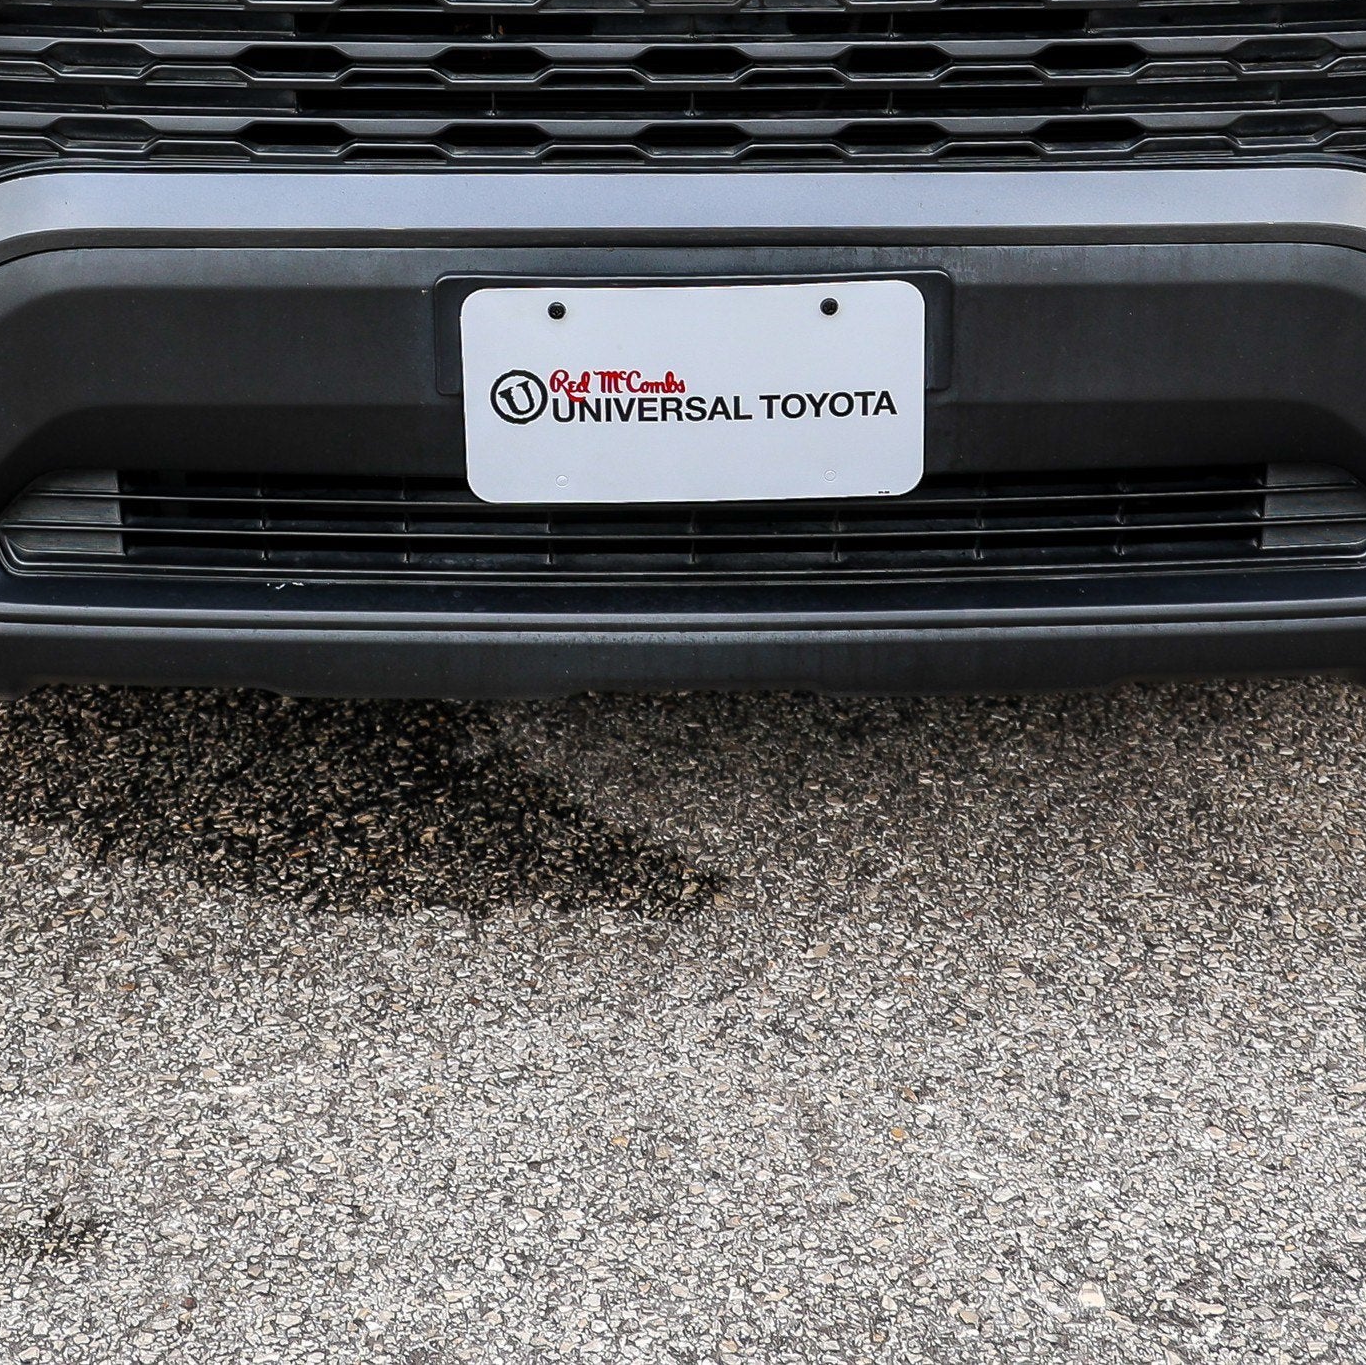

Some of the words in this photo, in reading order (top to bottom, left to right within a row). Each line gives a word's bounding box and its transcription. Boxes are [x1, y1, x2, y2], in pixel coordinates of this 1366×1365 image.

[549, 369, 590, 402] Red
[593, 370, 686, 394] McCombs
[552, 395, 753, 423] UNIVERSAL
[759, 390, 898, 419] TOYOTA
